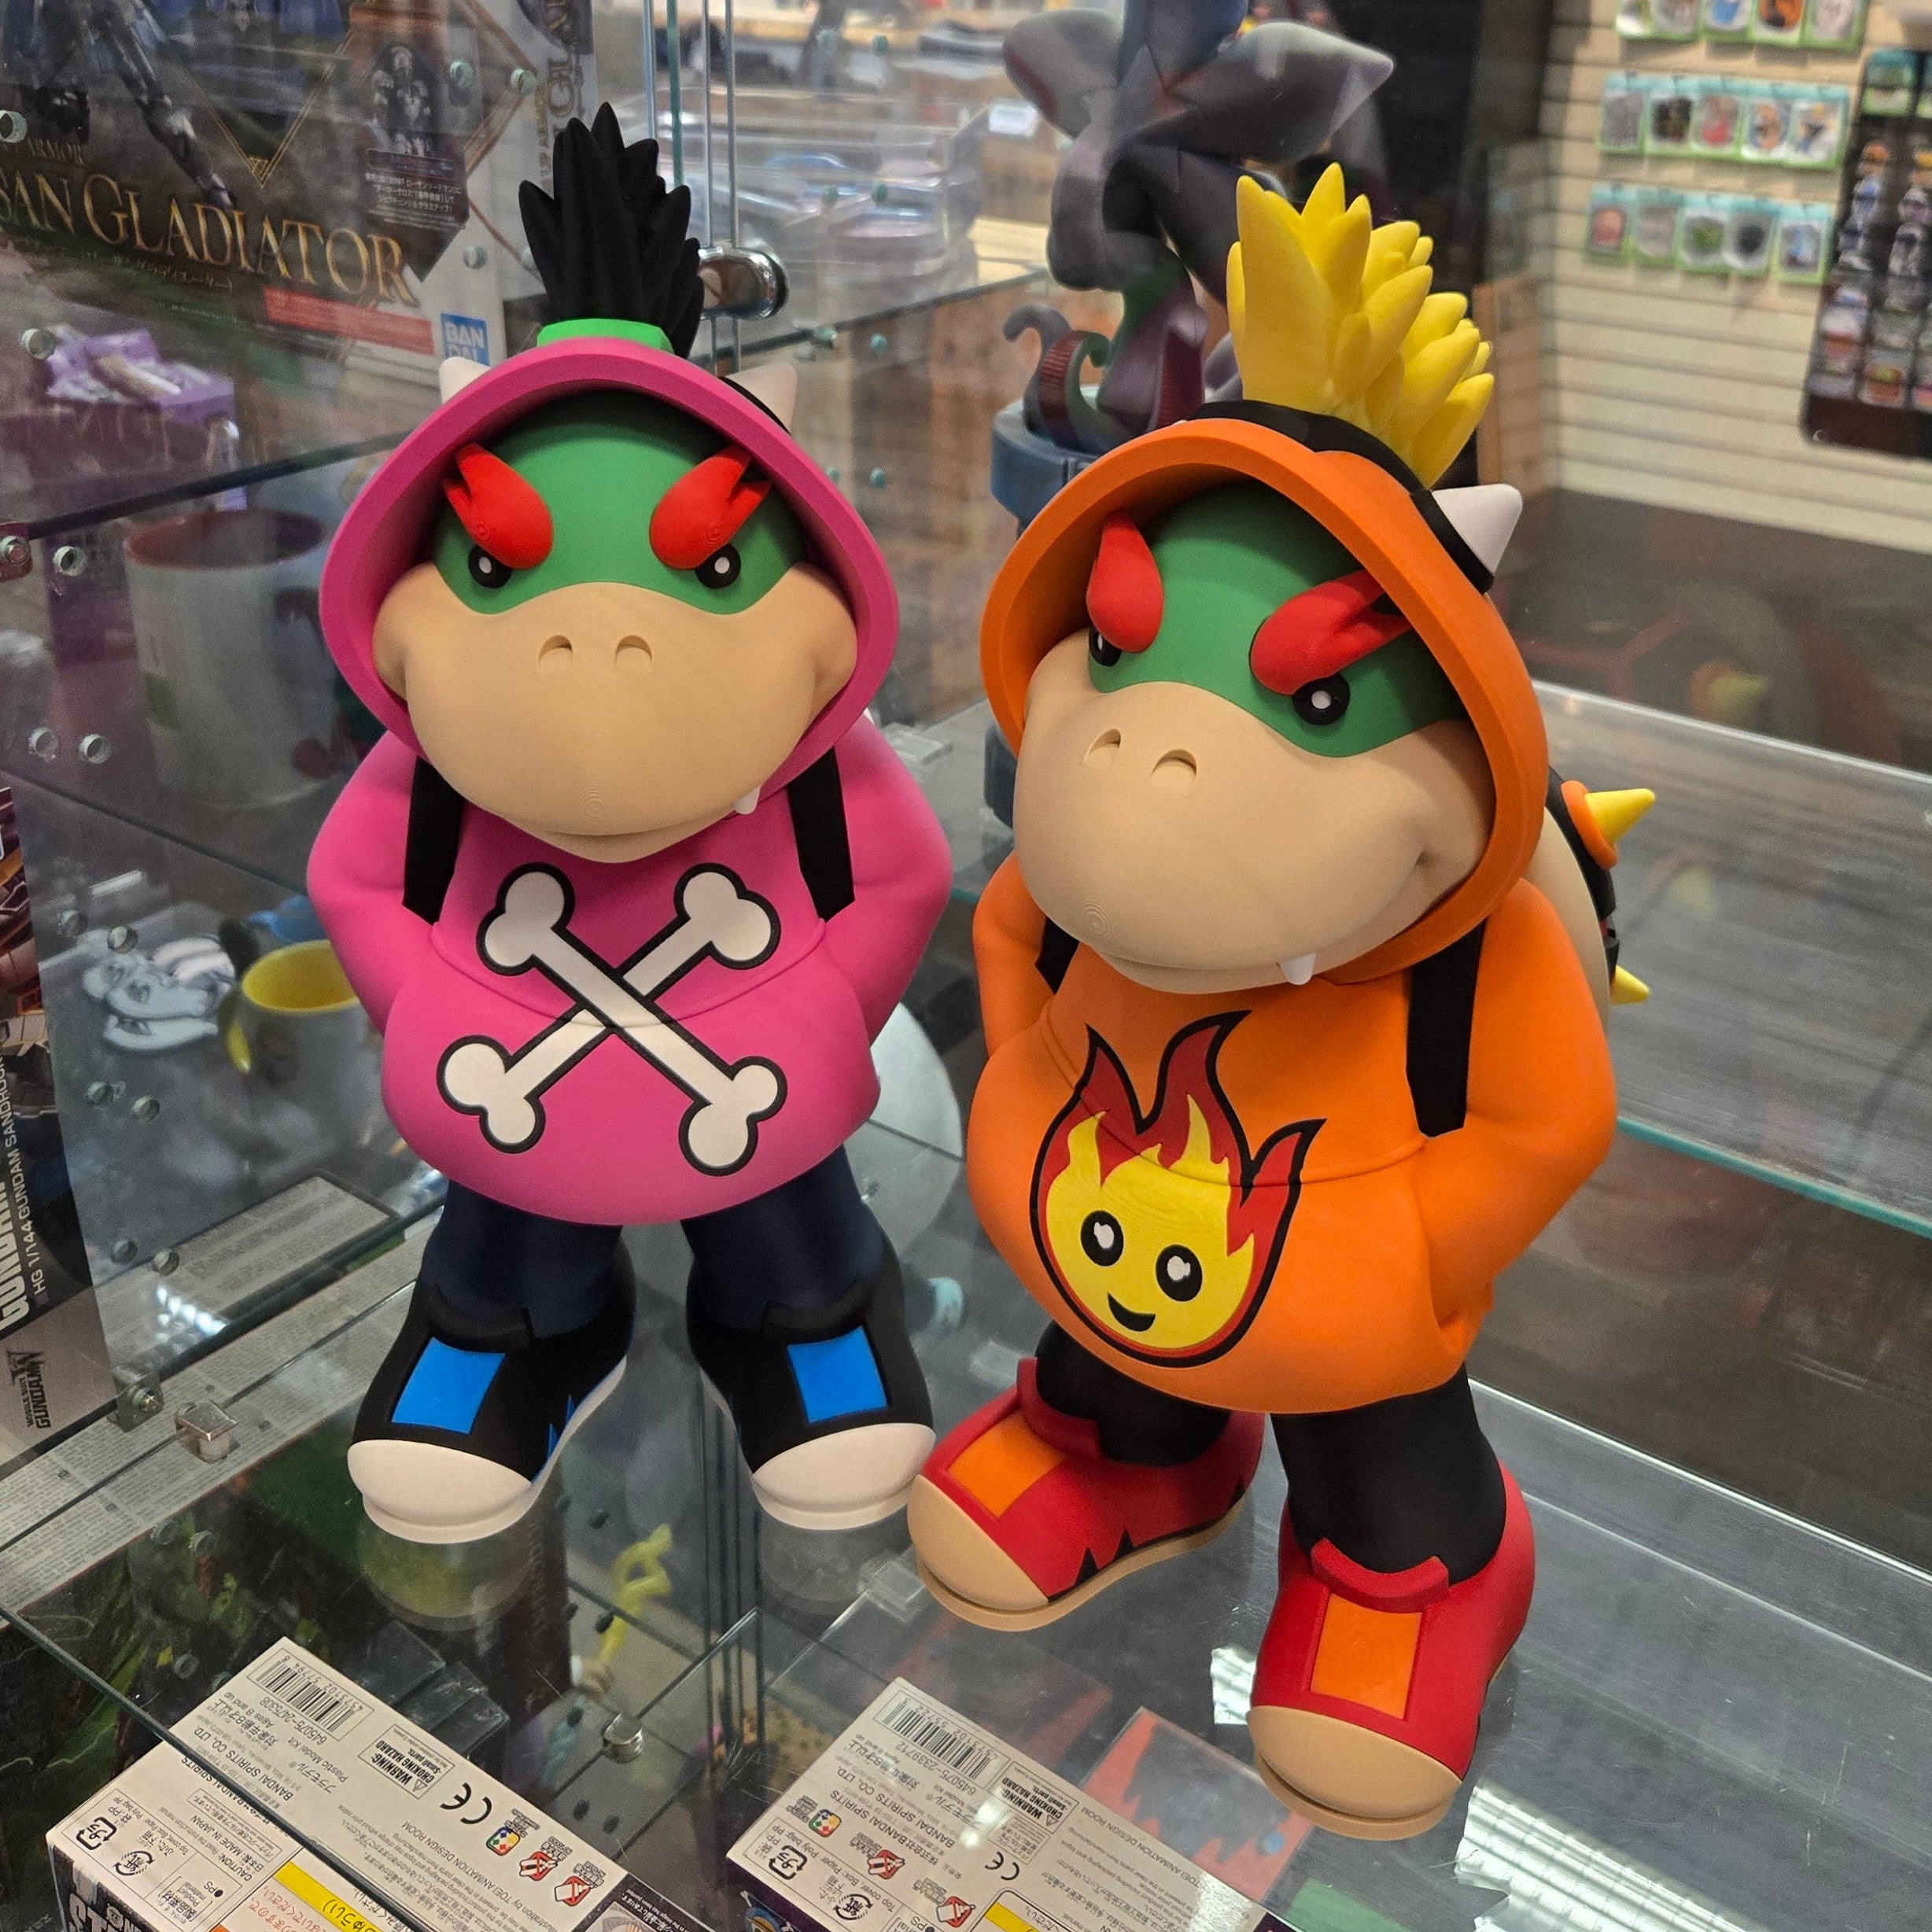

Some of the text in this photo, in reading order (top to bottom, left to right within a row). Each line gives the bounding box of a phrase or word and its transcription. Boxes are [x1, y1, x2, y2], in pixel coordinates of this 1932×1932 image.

[83, 172, 419, 308] GLADIATOR
[445, 323, 485, 349] BAN
[7, 1149, 31, 1219] GUNDAM
[21, 1219, 39, 1267] 1/144
[31, 1268, 46, 1295] HG
[18, 1376, 34, 1427] MOBILE SUIT
[290, 1661, 323, 1683] 57794
[222, 1690, 236, 1701] up
[230, 1698, 249, 1711] and
[322, 1682, 365, 1713] 4573102
[211, 1698, 278, 1746] 対象年齢8才以上
[252, 1711, 275, 1729] Ages
[258, 1695, 329, 1746] 645075-2475308
[913, 1703, 949, 1728] 55722
[191, 1725, 212, 1741] LTD.
[854, 1731, 866, 1741] up
[207, 1736, 229, 1753] CO.,
[230, 1738, 249, 1752] Tokyo
[951, 1727, 1000, 1761] 4573102
[223, 1749, 262, 1777] SPIRITS
[286, 1736, 349, 1783] Plastic Model Kit
[374, 1738, 436, 1783] CHOKING HAZARD
[404, 1746, 426, 1763] parts.
[367, 1751, 415, 1785] WARNING:
[894, 1739, 978, 1796] 645075-2339712
[257, 1773, 293, 1801] BANDAI
[932, 1783, 946, 1793] Kit
[1000, 1775, 1032, 1799] HAZARD
[112, 1795, 124, 1804] PP
[828, 1789, 870, 1820] SPIRITS
[834, 1765, 955, 1848] BANDAI SPIRITS CO., LTD.
[997, 1786, 1044, 1820] WARNING:
[1027, 1794, 1064, 1820] CHOKING
[130, 1808, 145, 1819] Poly
[142, 1816, 160, 1831] Paper
[350, 1813, 364, 1824] prior
[189, 1814, 216, 1834] JAPAN
[359, 1821, 379, 1835] without
[400, 1820, 427, 1841] ROOM
[211, 1831, 223, 1841] IN
[376, 1832, 396, 1847] change
[770, 1823, 821, 1858] Poly bag: PP
[868, 1815, 940, 1865] 株式会社BANDAI
[1079, 1805, 1201, 1886] TOEI ANIMATION DESIGN ROOM
[177, 1844, 190, 1854] Top
[219, 1837, 244, 1856] MADE
[392, 1844, 406, 1854] may
[422, 1837, 455, 1861] DESIGN
[216, 1853, 254, 1881] CAUTION:
[415, 1860, 426, 1869] and
[425, 1857, 440, 1869] from
[437, 1865, 454, 1879] parts
[422, 1866, 450, 1886] packaging
[450, 1876, 466, 1888] clear
[452, 1857, 496, 1890] ANIMATION
[818, 1853, 898, 1912] Top cover, Box: Paper
[175, 1886, 202, 1906] Product
[181, 1880, 208, 1901] material
[446, 1883, 470, 1901] including
[463, 1885, 475, 1894] the
[491, 1886, 514, 1904] TOEI
[159, 1890, 199, 1919] 製品素材
[466, 1898, 488, 1914] product
[477, 1894, 500, 1912] present
[510, 1898, 525, 1910] by
[244, 1897, 297, 1932] りますので、
[484, 1912, 496, 1921] this
[498, 1911, 509, 1919] be
[506, 1915, 522, 1927] may
